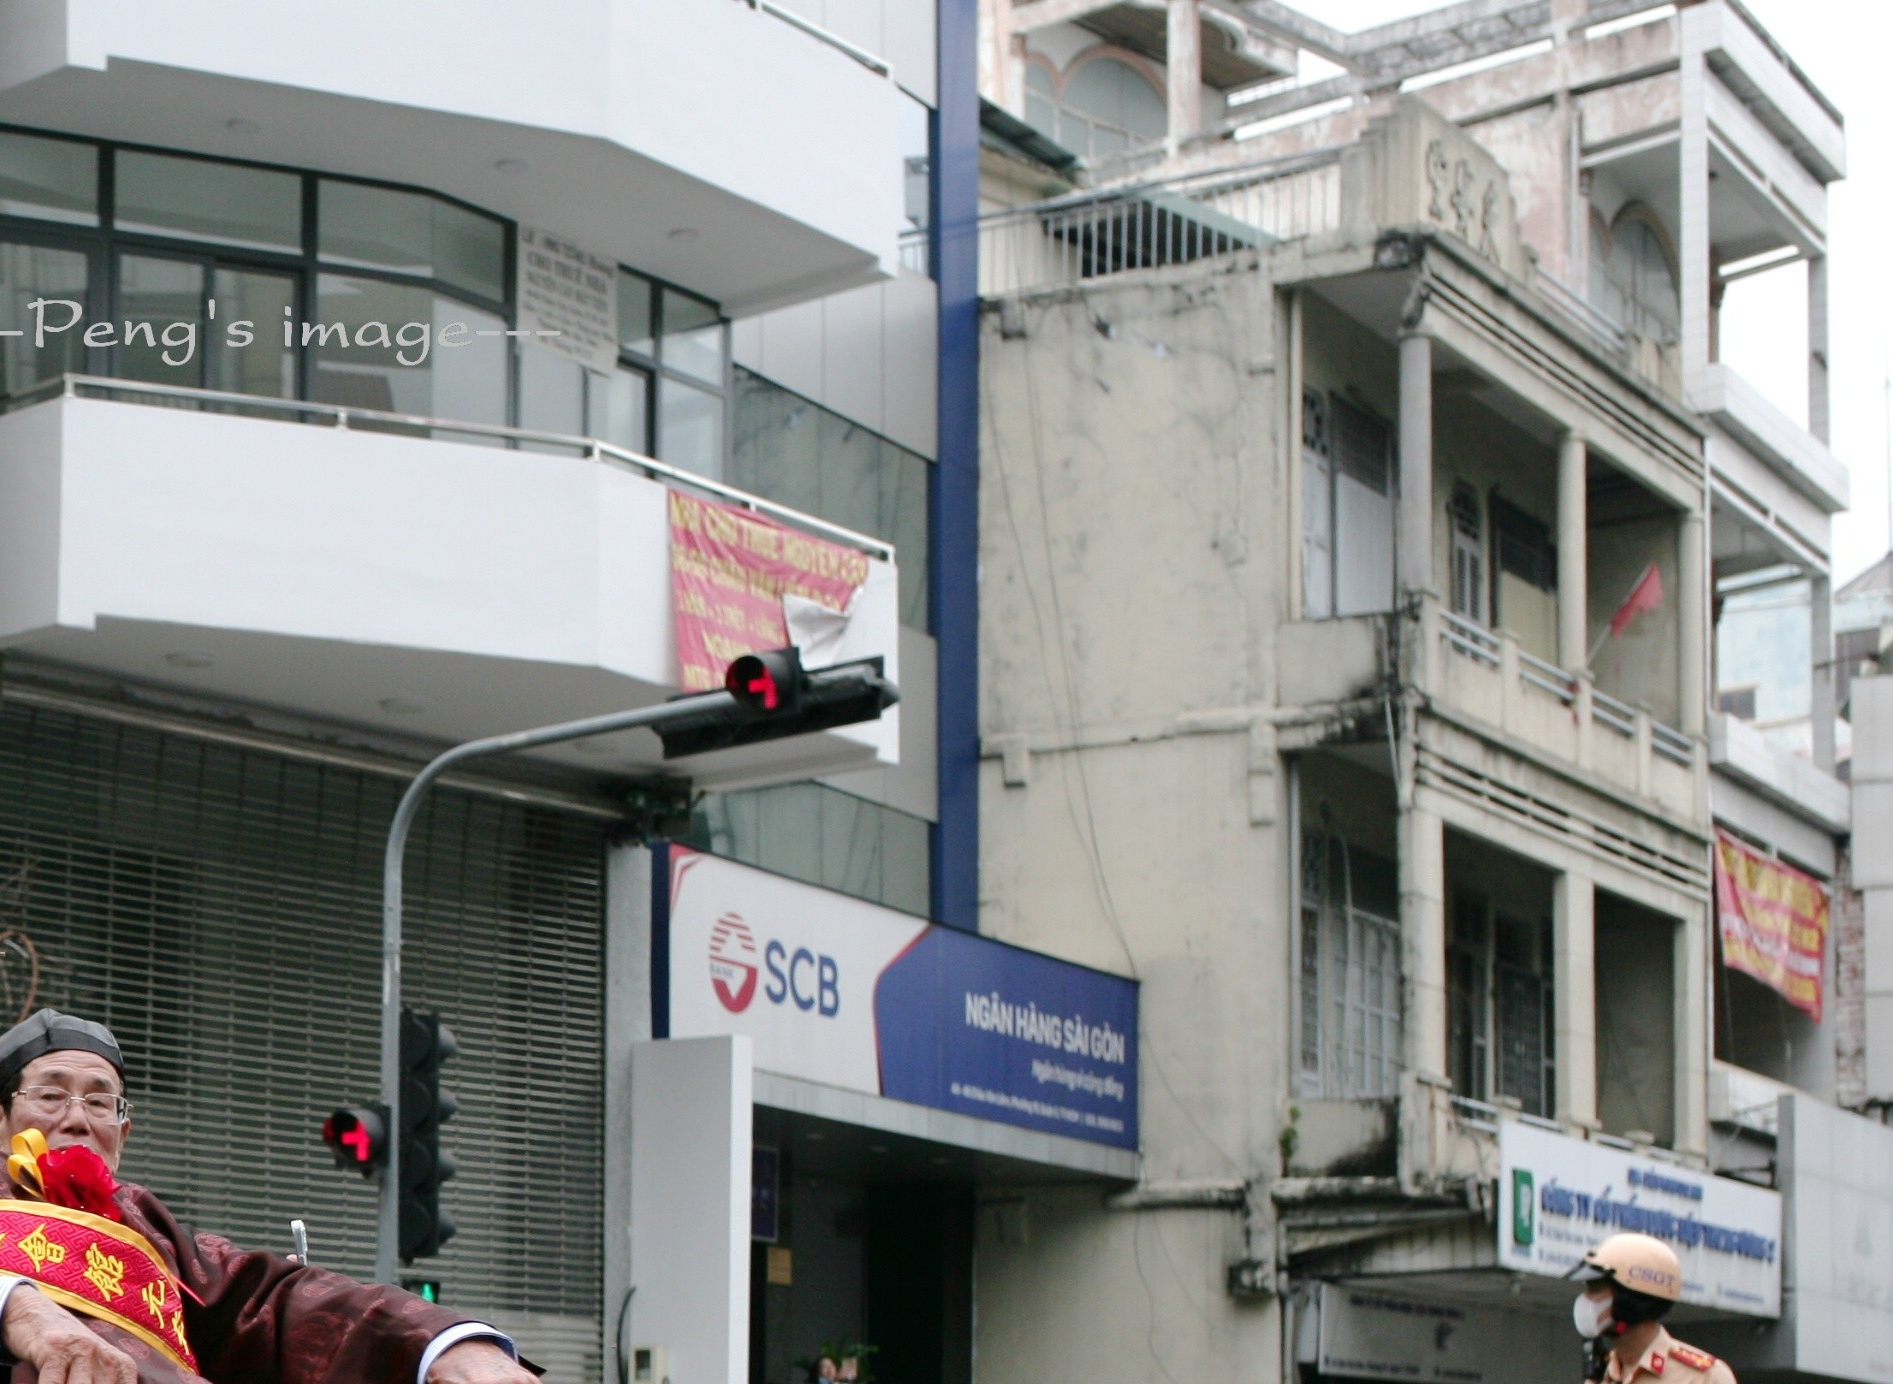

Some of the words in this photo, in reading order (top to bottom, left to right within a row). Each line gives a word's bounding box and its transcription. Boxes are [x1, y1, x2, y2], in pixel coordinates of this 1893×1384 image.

[764, 939, 840, 1018] SCB
[965, 990, 1015, 1037] NGÂN
[1014, 1001, 1063, 1050] HÀNG
